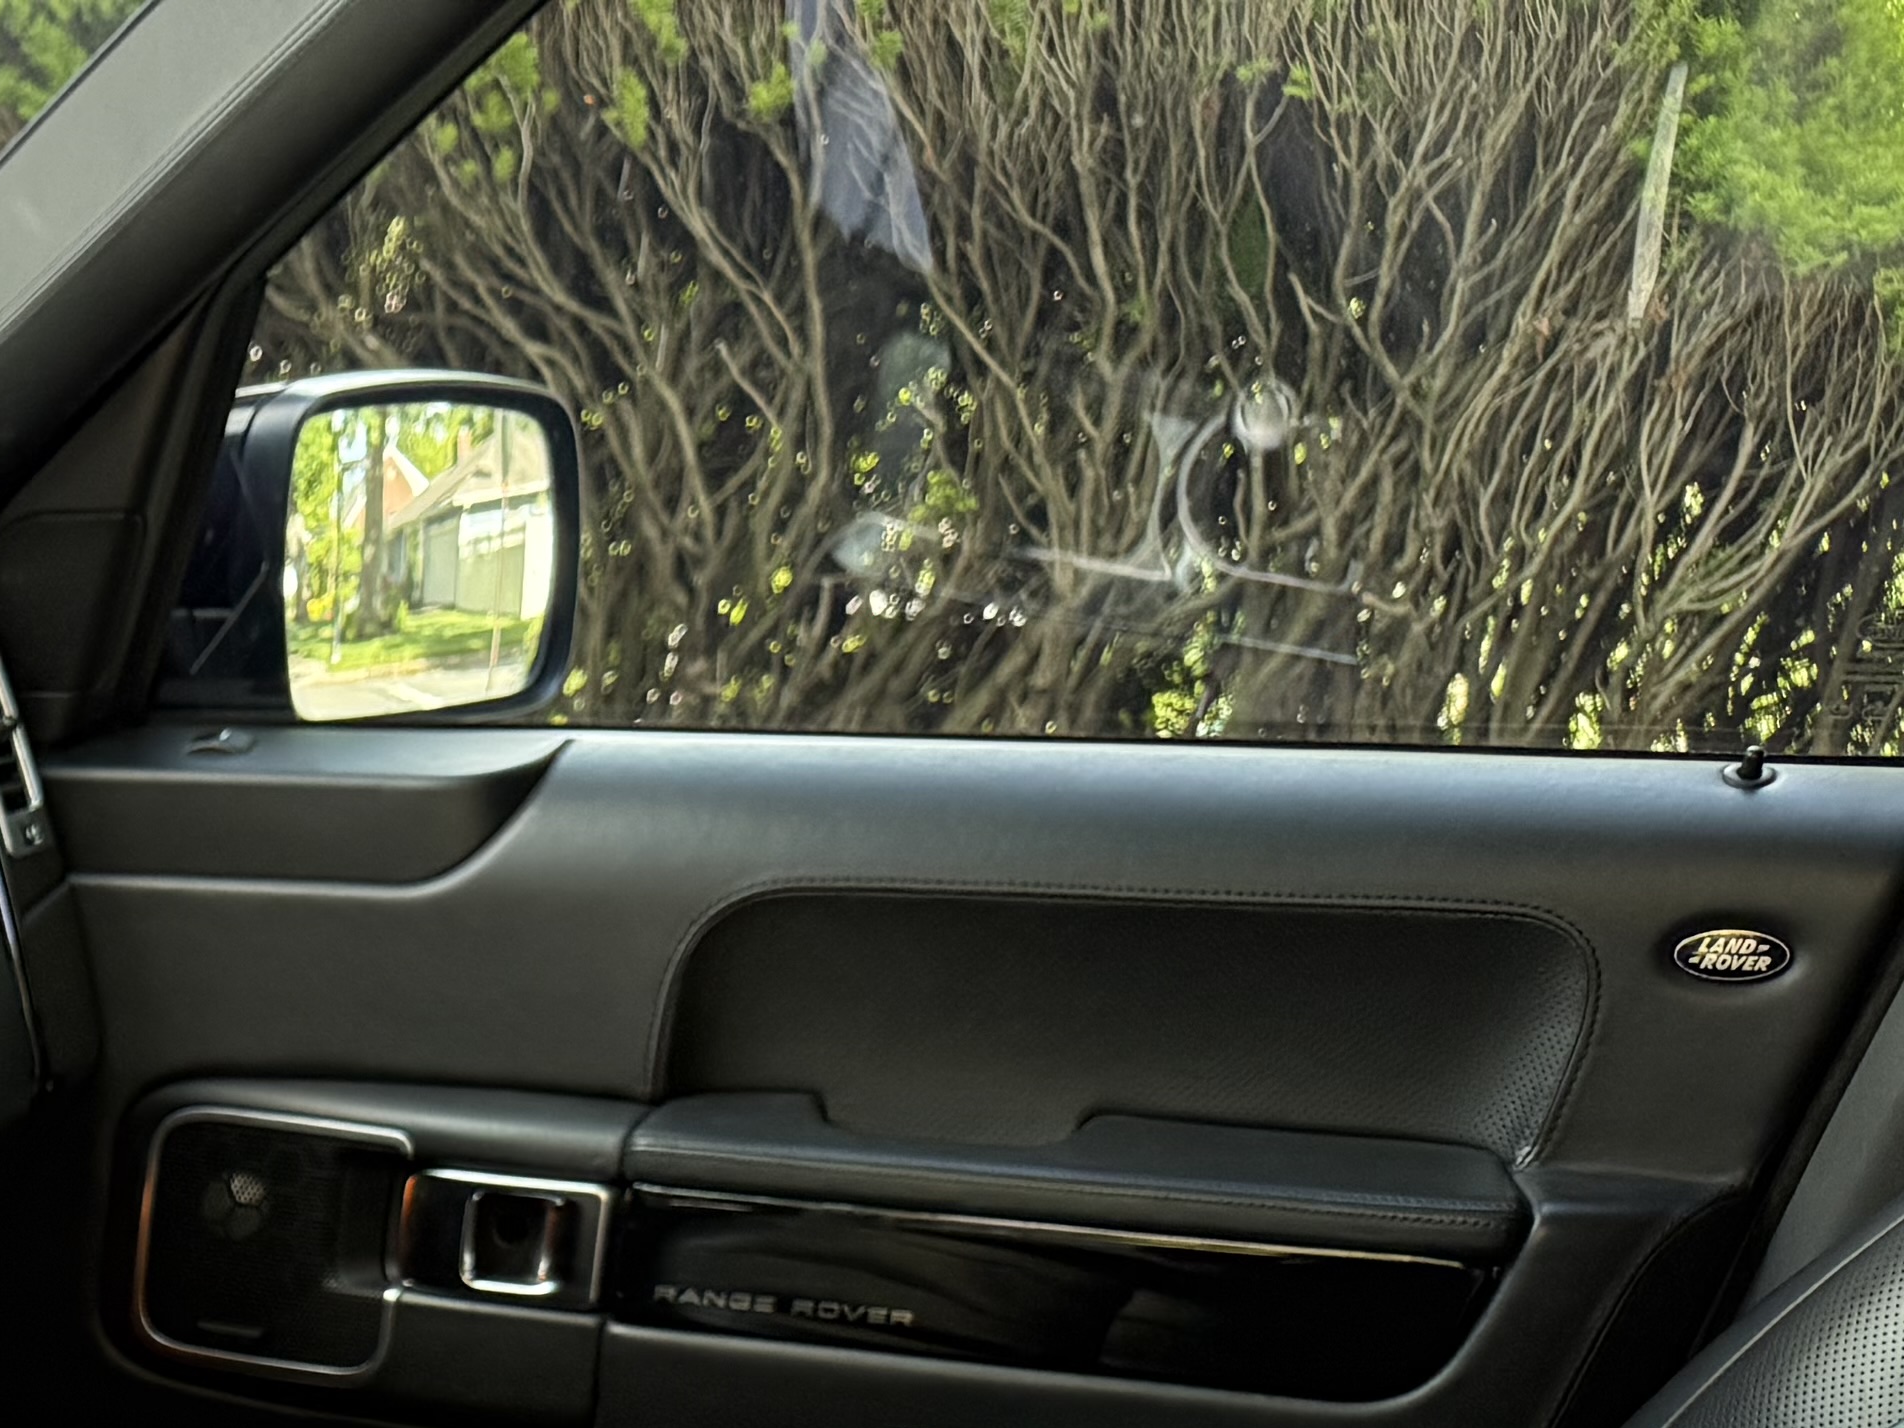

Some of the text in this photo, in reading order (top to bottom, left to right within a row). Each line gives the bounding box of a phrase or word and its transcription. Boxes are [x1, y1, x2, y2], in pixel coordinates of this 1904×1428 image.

[1695, 937, 1758, 954] LAND
[1699, 955, 1773, 971] ROVER
[653, 1283, 914, 1327] RANGE ROVER
